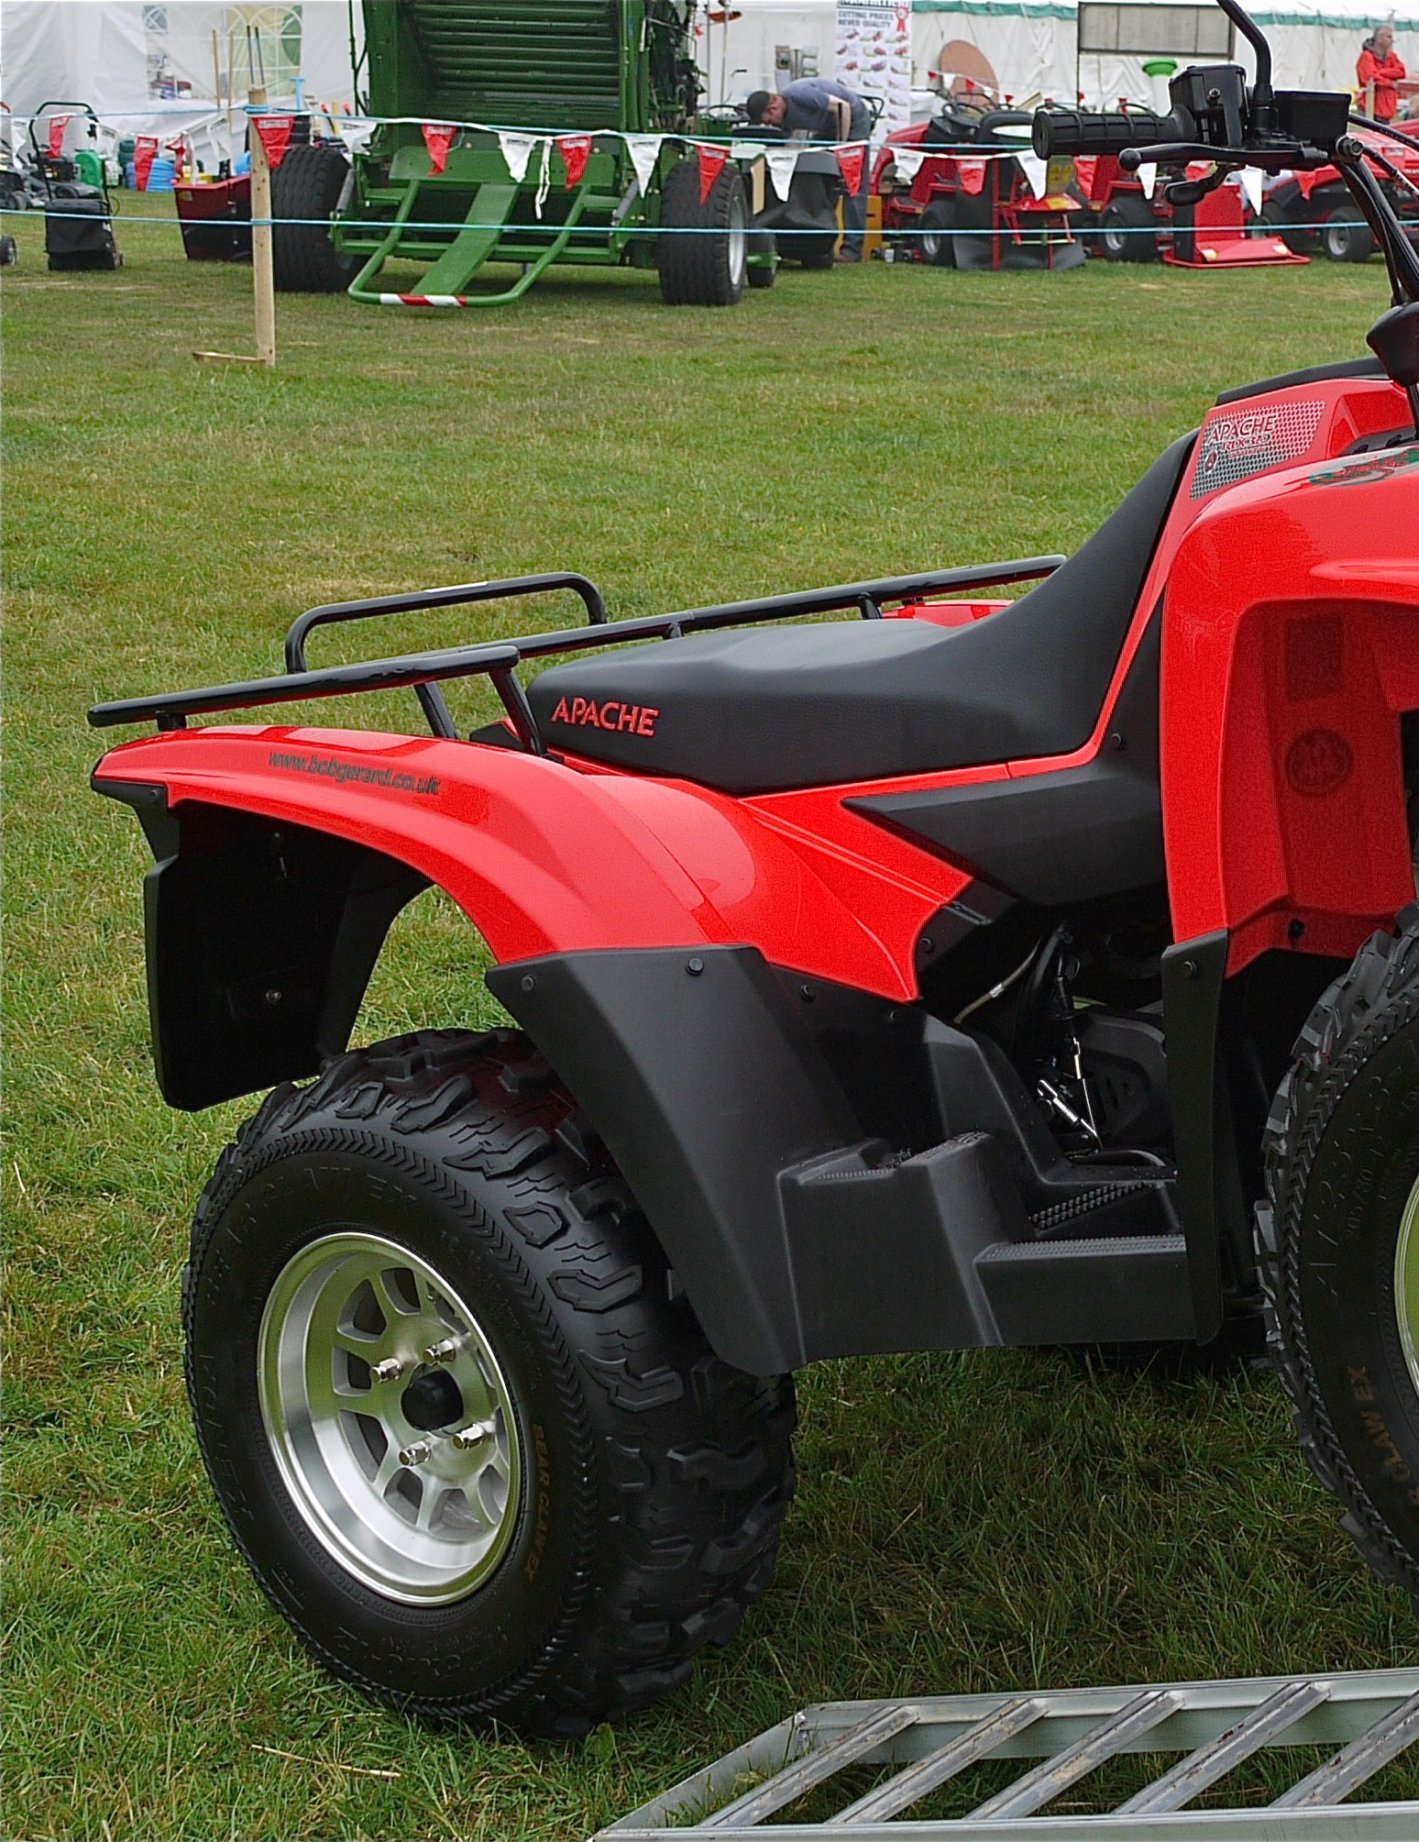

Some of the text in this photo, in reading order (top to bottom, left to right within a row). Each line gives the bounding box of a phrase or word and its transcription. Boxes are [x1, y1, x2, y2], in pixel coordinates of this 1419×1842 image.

[863, 20, 891, 28] QUALITY
[870, 12, 894, 20] PRICES
[1208, 414, 1277, 445] APACHE
[551, 695, 660, 737] APACHE
[269, 752, 441, 796] www.bobgerard.co.uk
[1348, 1365, 1375, 1401] EX
[532, 1423, 551, 1486] BEAR
[1360, 1411, 1411, 1481] CLAW
